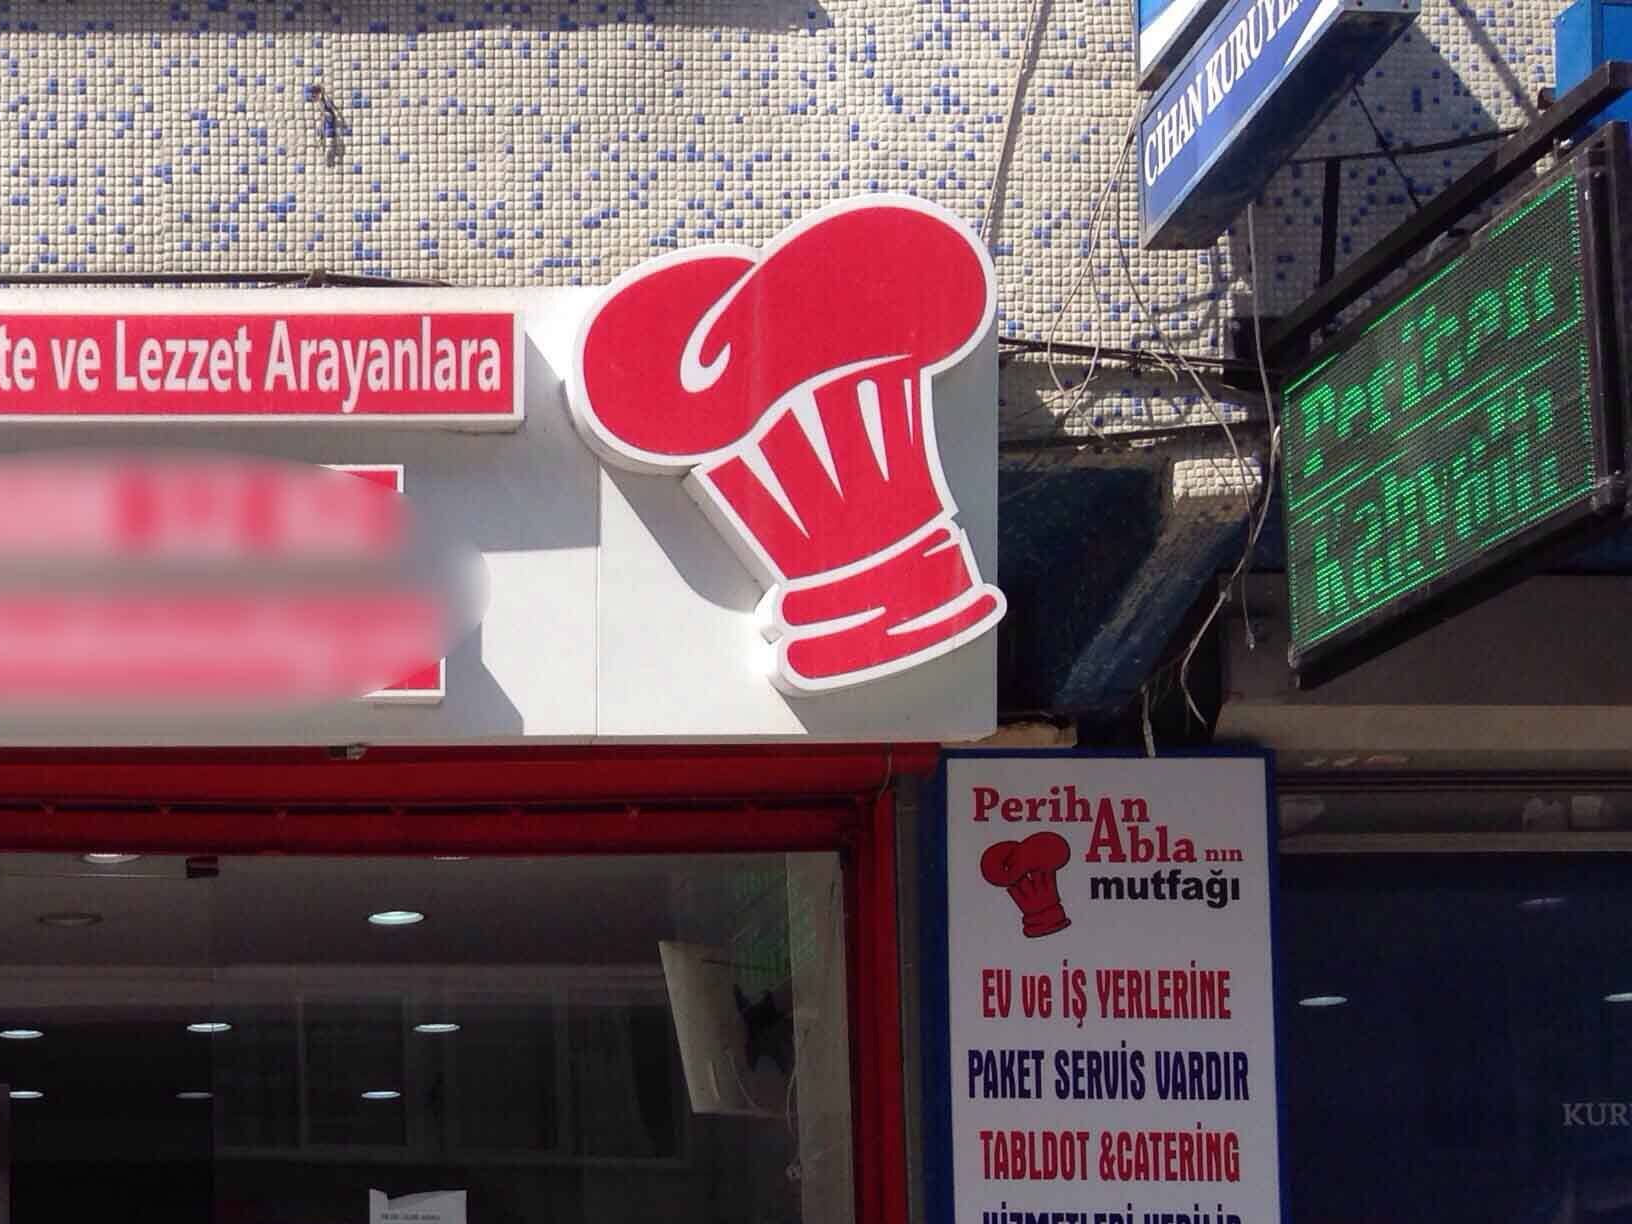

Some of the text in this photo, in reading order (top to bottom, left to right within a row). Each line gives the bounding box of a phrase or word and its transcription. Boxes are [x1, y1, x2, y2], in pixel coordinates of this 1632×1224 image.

[1144, 75, 1204, 187] CİHAN
[52, 342, 100, 391] ve
[116, 318, 252, 392] Lezzet
[264, 318, 502, 413] Arayanlara
[1090, 869, 1241, 908] mutfağı
[983, 960, 1232, 1028] EV ve İŞ YERLERİNE
[968, 1040, 1250, 1101] PAKET SERVİS VARDIR
[1563, 1101, 1632, 1127] KUR
[980, 1129, 1089, 1181] TABLDOT
